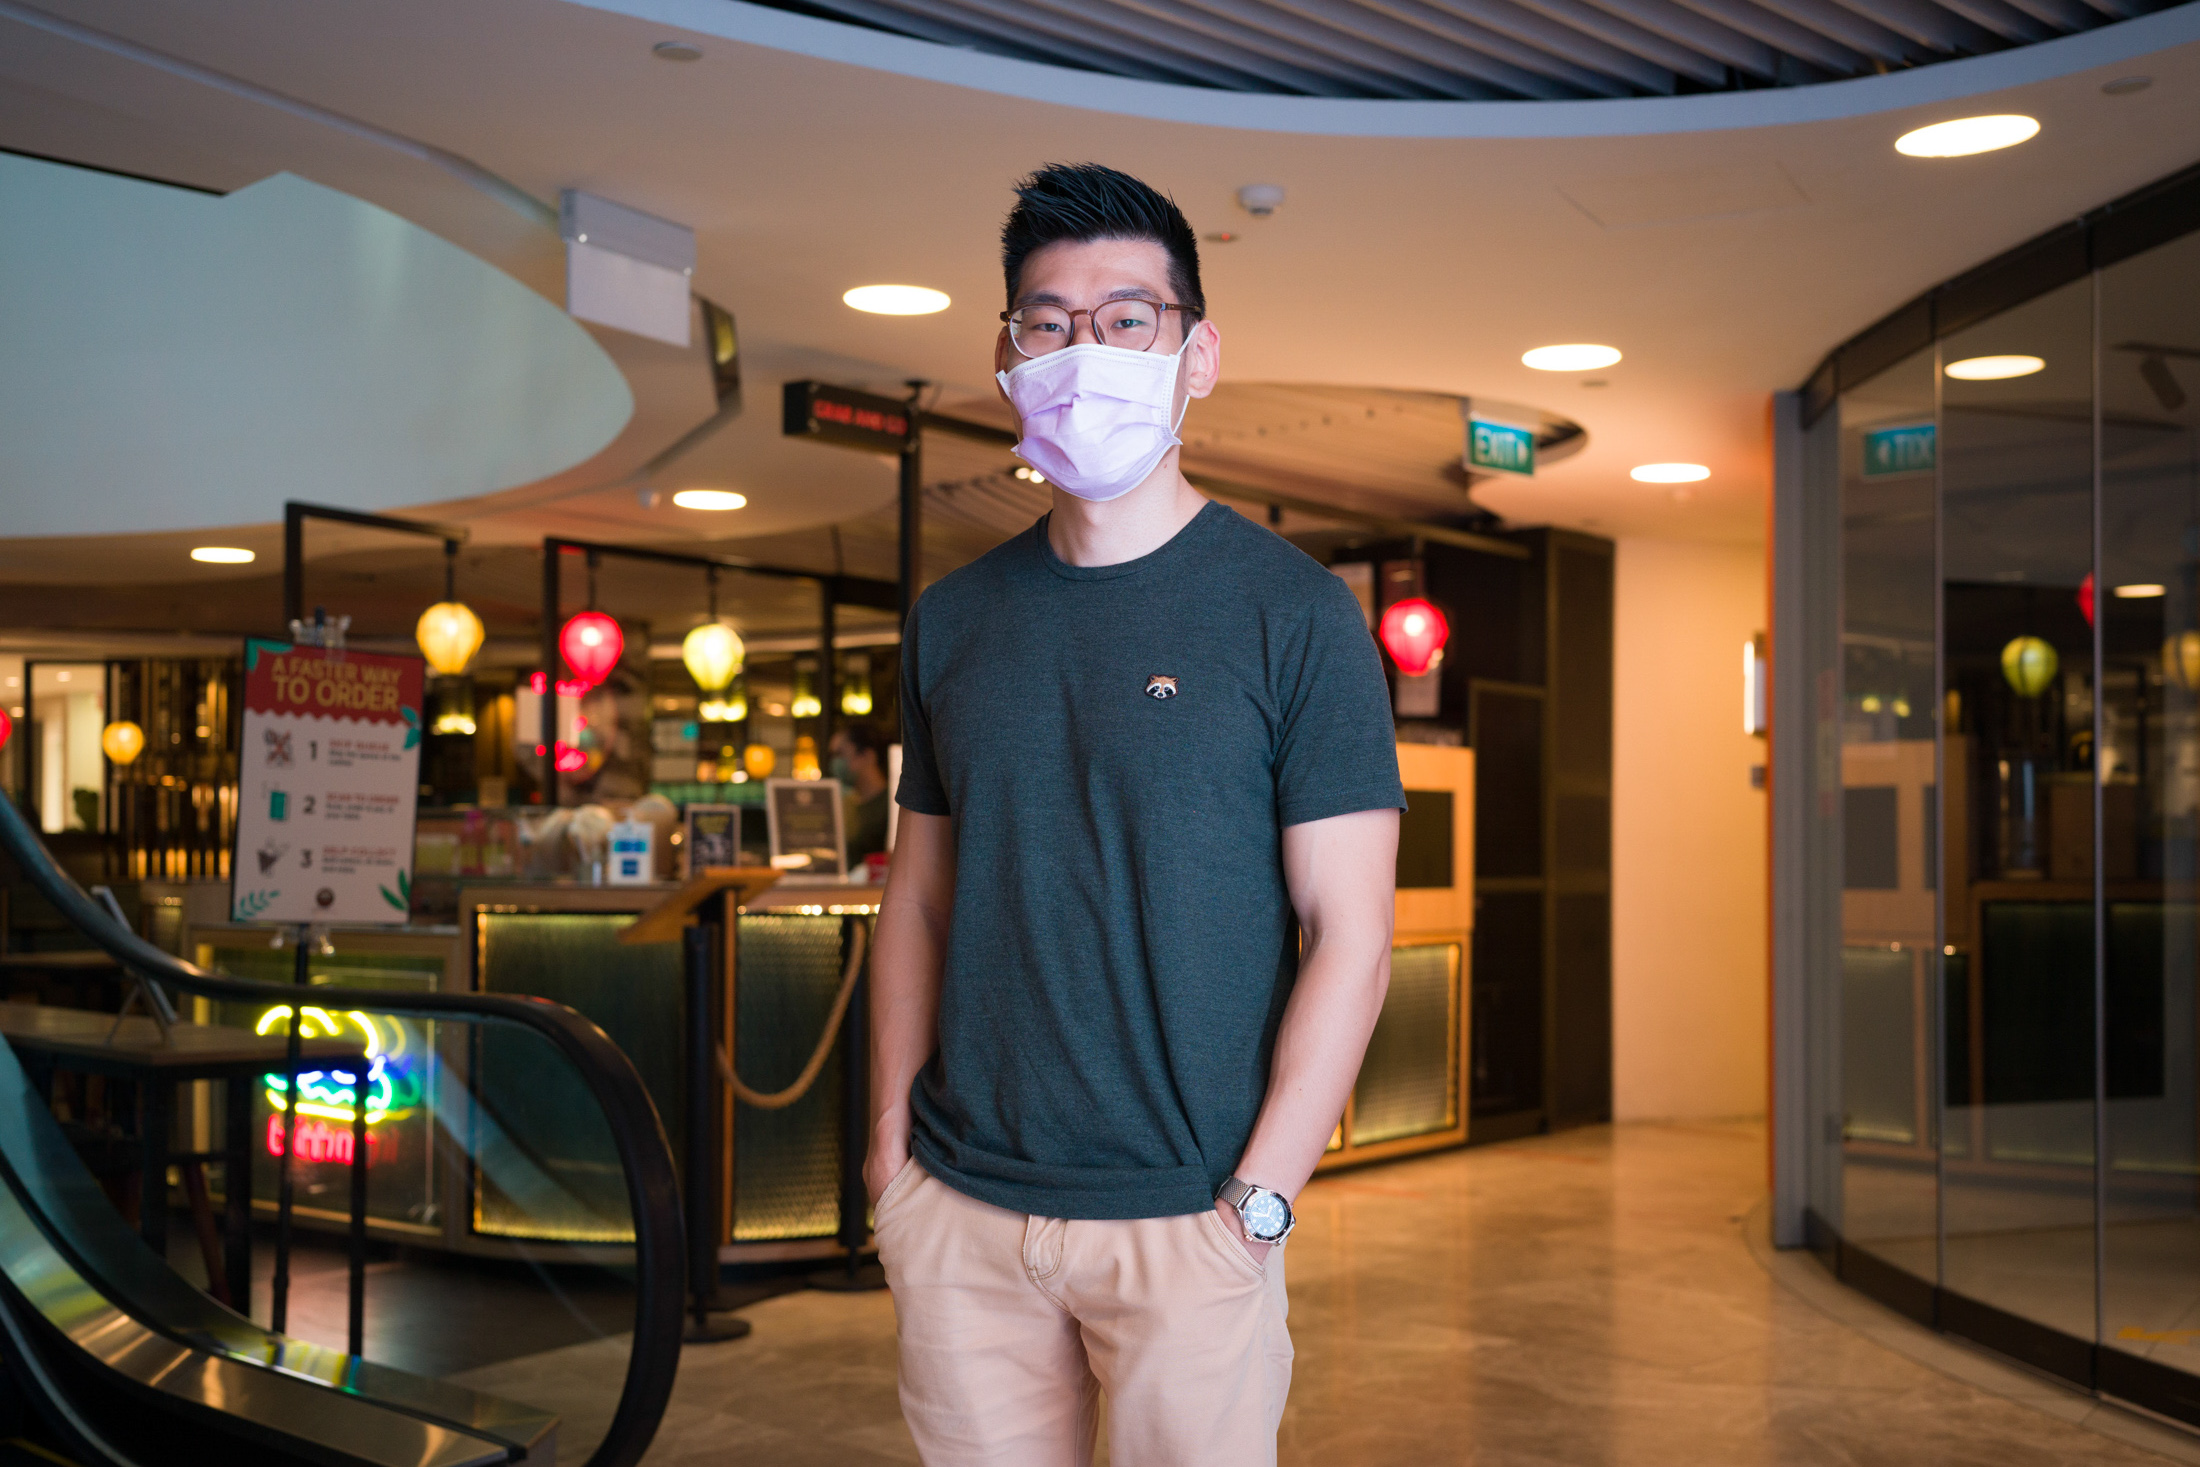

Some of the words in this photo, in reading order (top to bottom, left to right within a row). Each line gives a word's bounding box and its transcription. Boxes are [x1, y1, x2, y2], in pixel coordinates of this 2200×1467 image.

[1474, 427, 1516, 465] EXIT
[271, 656, 287, 674] A
[289, 657, 358, 681] FASTER
[361, 664, 403, 685] WAY
[271, 674, 310, 704] TO
[315, 679, 400, 712] ORDER
[309, 740, 318, 760] 1
[303, 796, 316, 815] 2
[301, 849, 313, 869] 3
